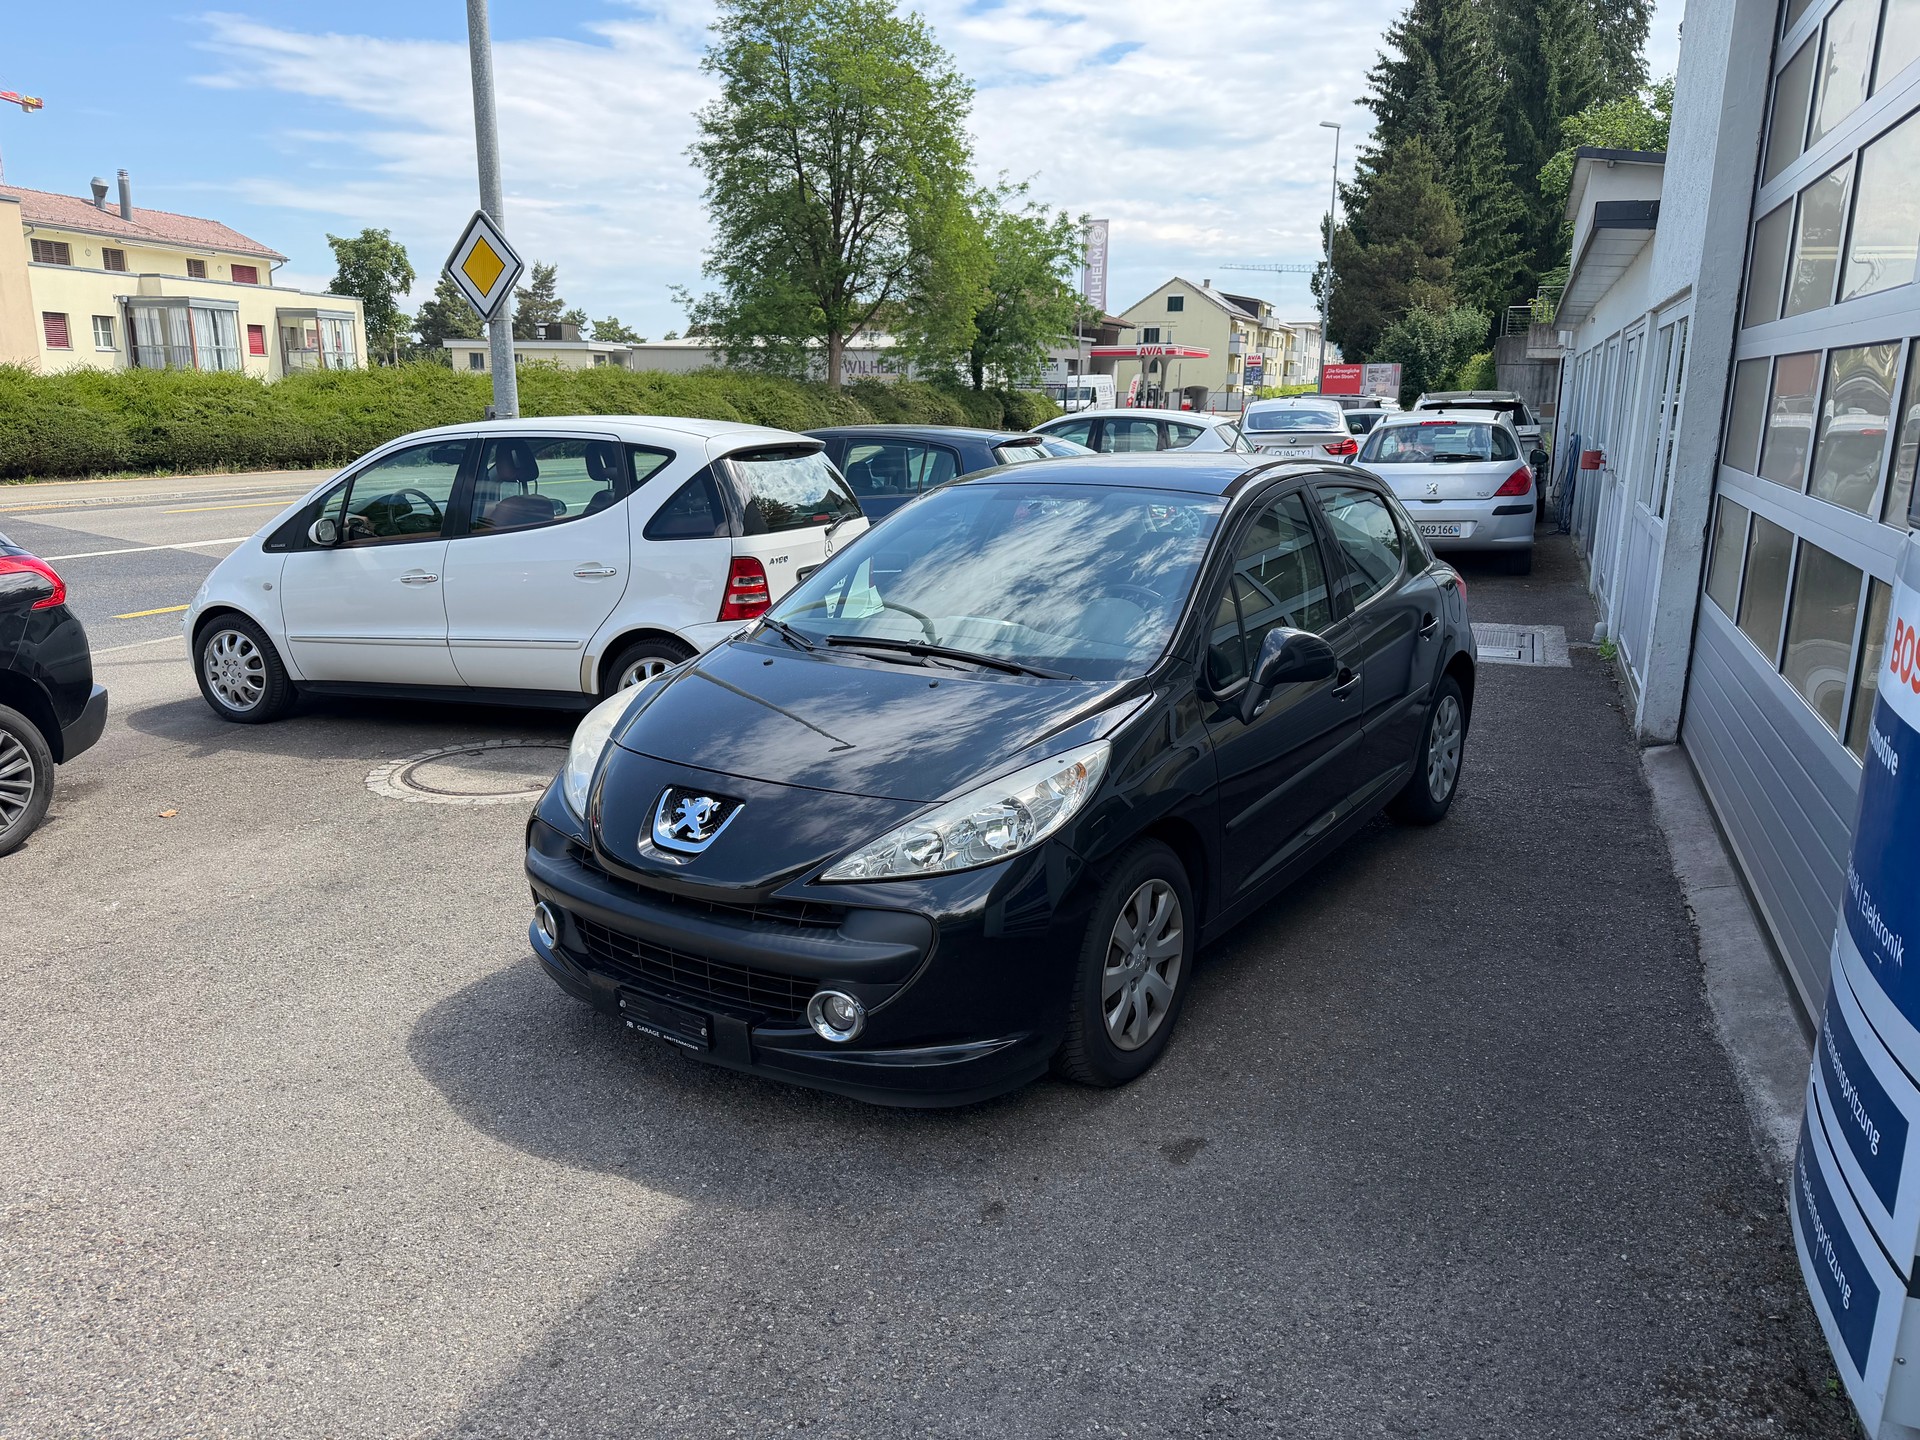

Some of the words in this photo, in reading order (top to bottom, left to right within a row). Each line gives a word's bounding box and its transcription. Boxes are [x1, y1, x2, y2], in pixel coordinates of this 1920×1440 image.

[1090, 248, 1103, 310] WILHELM
[1140, 346, 1163, 356] AVIA
[843, 360, 909, 374] WILHELM
[1861, 889, 1905, 968] Elektronik
[636, 1024, 660, 1038] GARAGE
